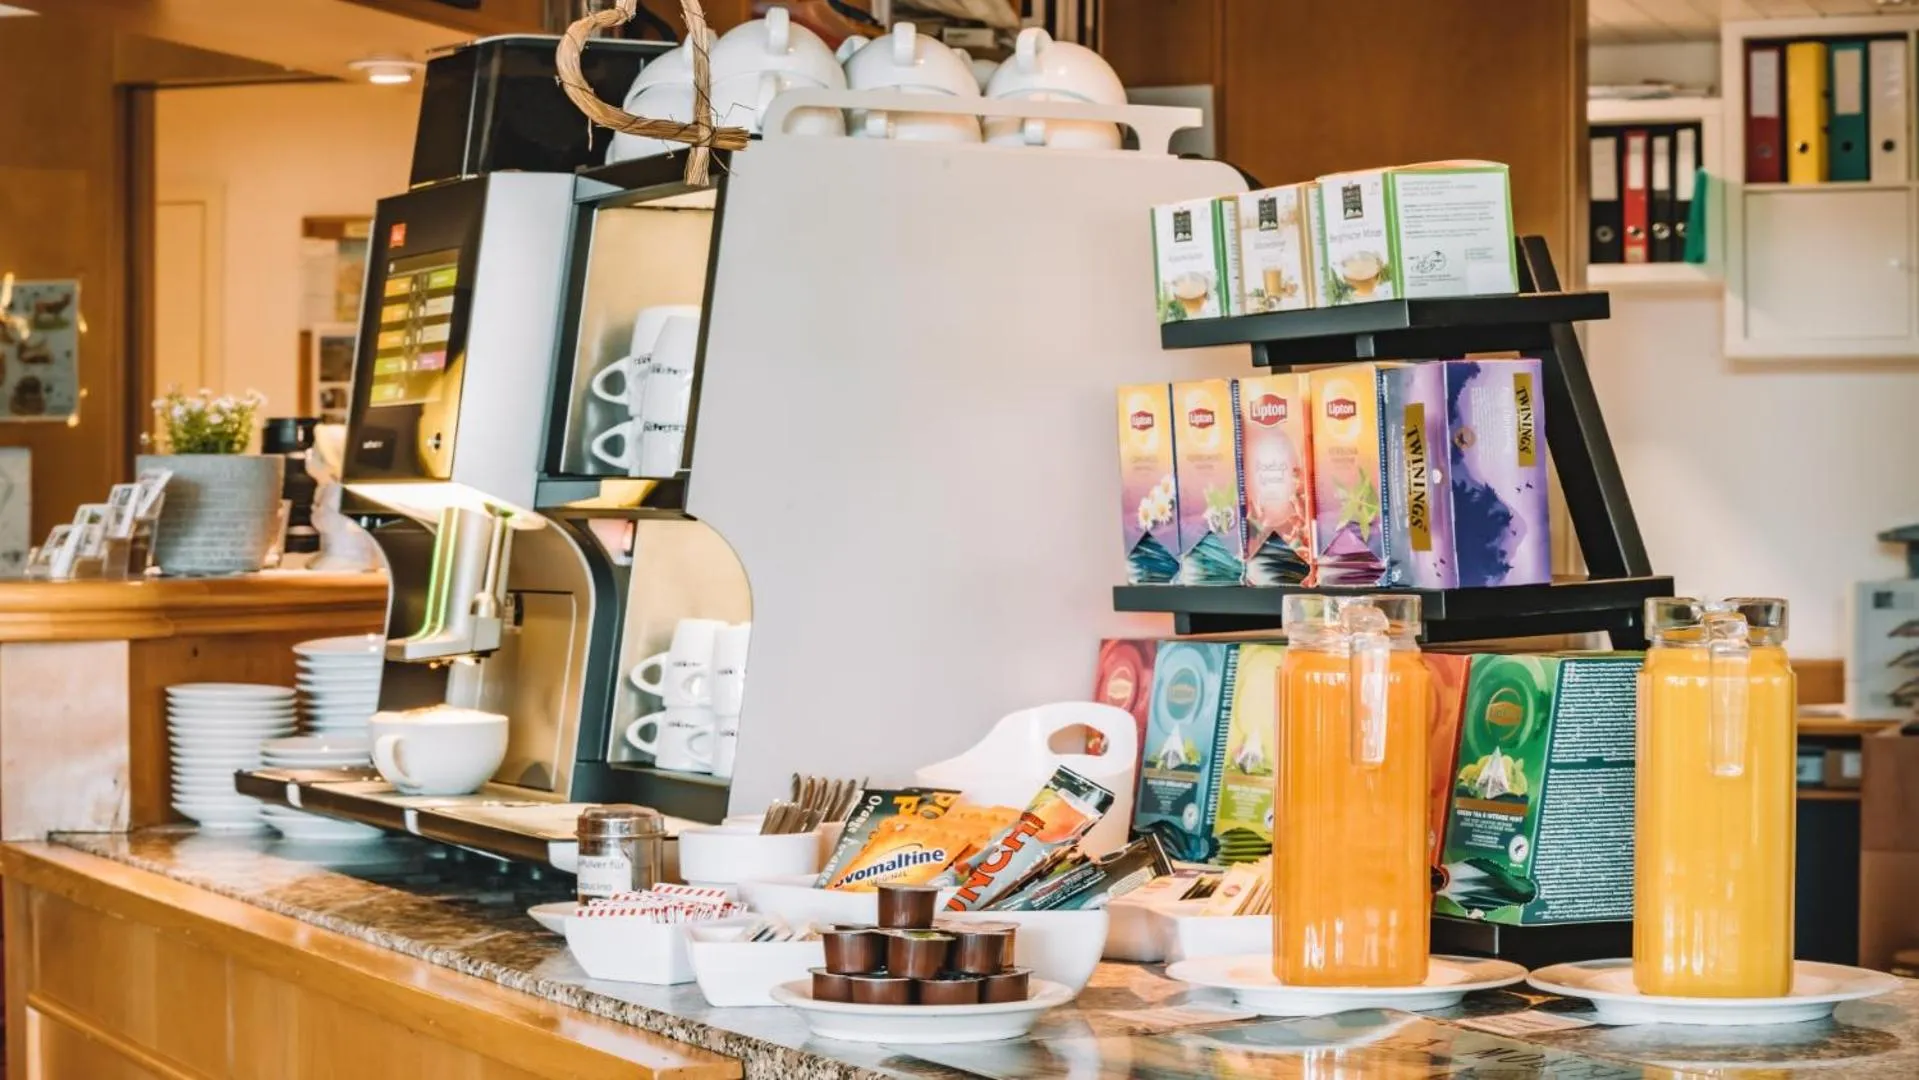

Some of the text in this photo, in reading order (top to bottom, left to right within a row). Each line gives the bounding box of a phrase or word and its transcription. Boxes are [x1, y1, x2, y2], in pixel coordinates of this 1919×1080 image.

[1253, 400, 1286, 420] Lipton
[1329, 404, 1353, 416] Lipton
[1131, 415, 1153, 427] Lipton
[1191, 414, 1213, 426] Lipton
[1515, 387, 1533, 454] TWININGS
[1407, 424, 1427, 531] TWININGS
